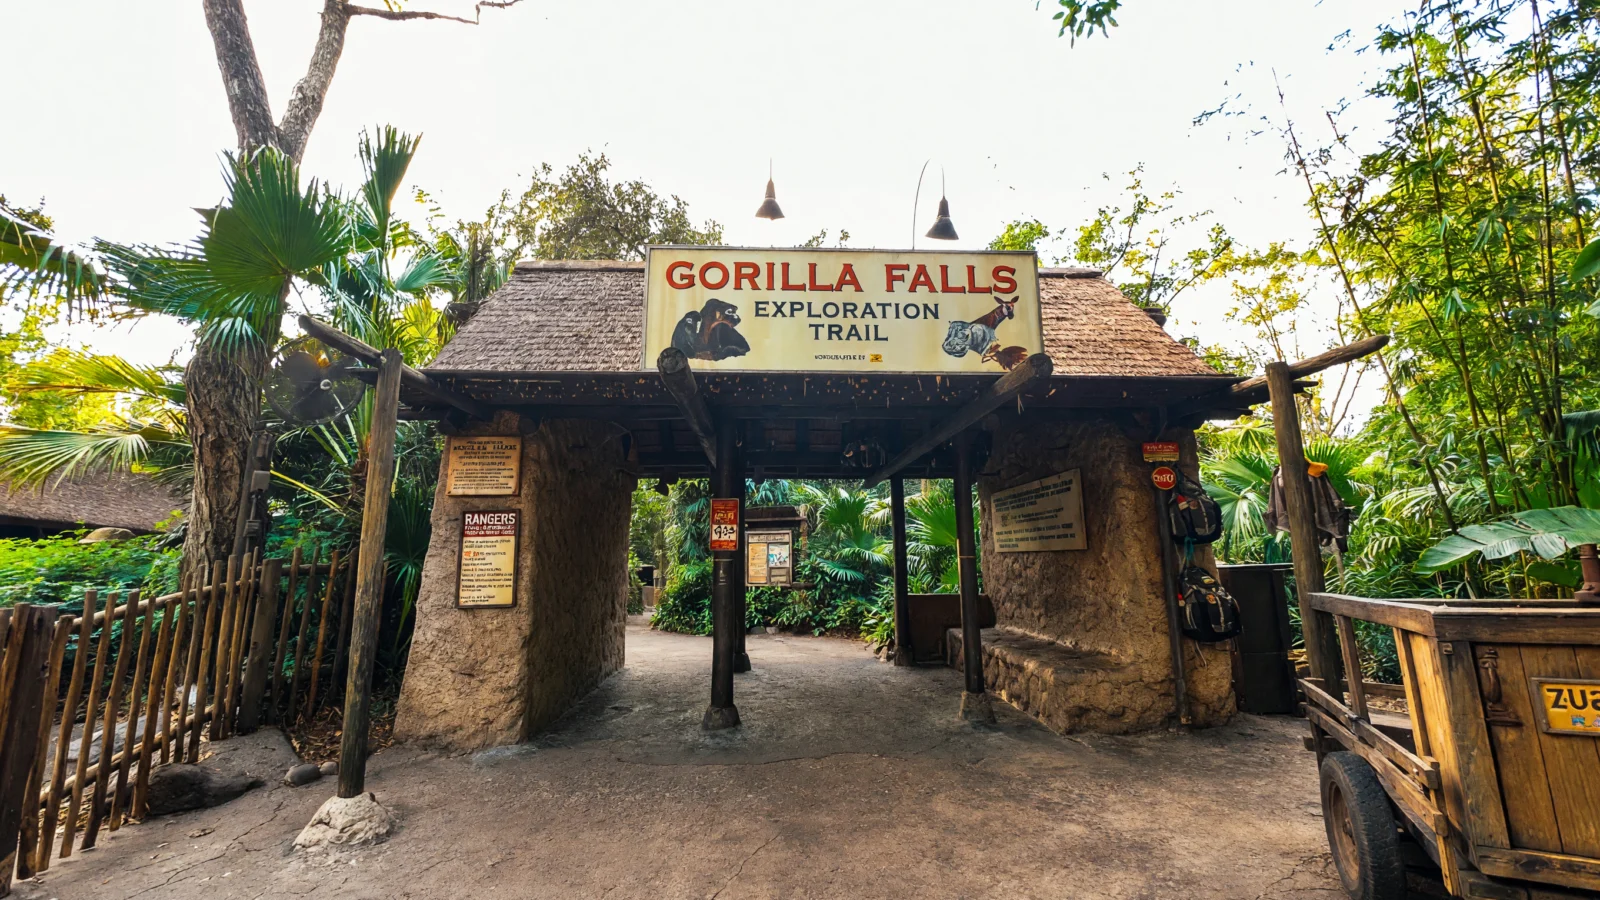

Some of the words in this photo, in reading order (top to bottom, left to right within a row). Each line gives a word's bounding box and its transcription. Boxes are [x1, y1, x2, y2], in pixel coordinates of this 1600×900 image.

[666, 260, 864, 293] GORILLA
[885, 263, 1018, 295] FALLS
[754, 300, 940, 320] EXPLORATION
[808, 323, 889, 342] TRAIL
[464, 513, 516, 525] RANGERS
